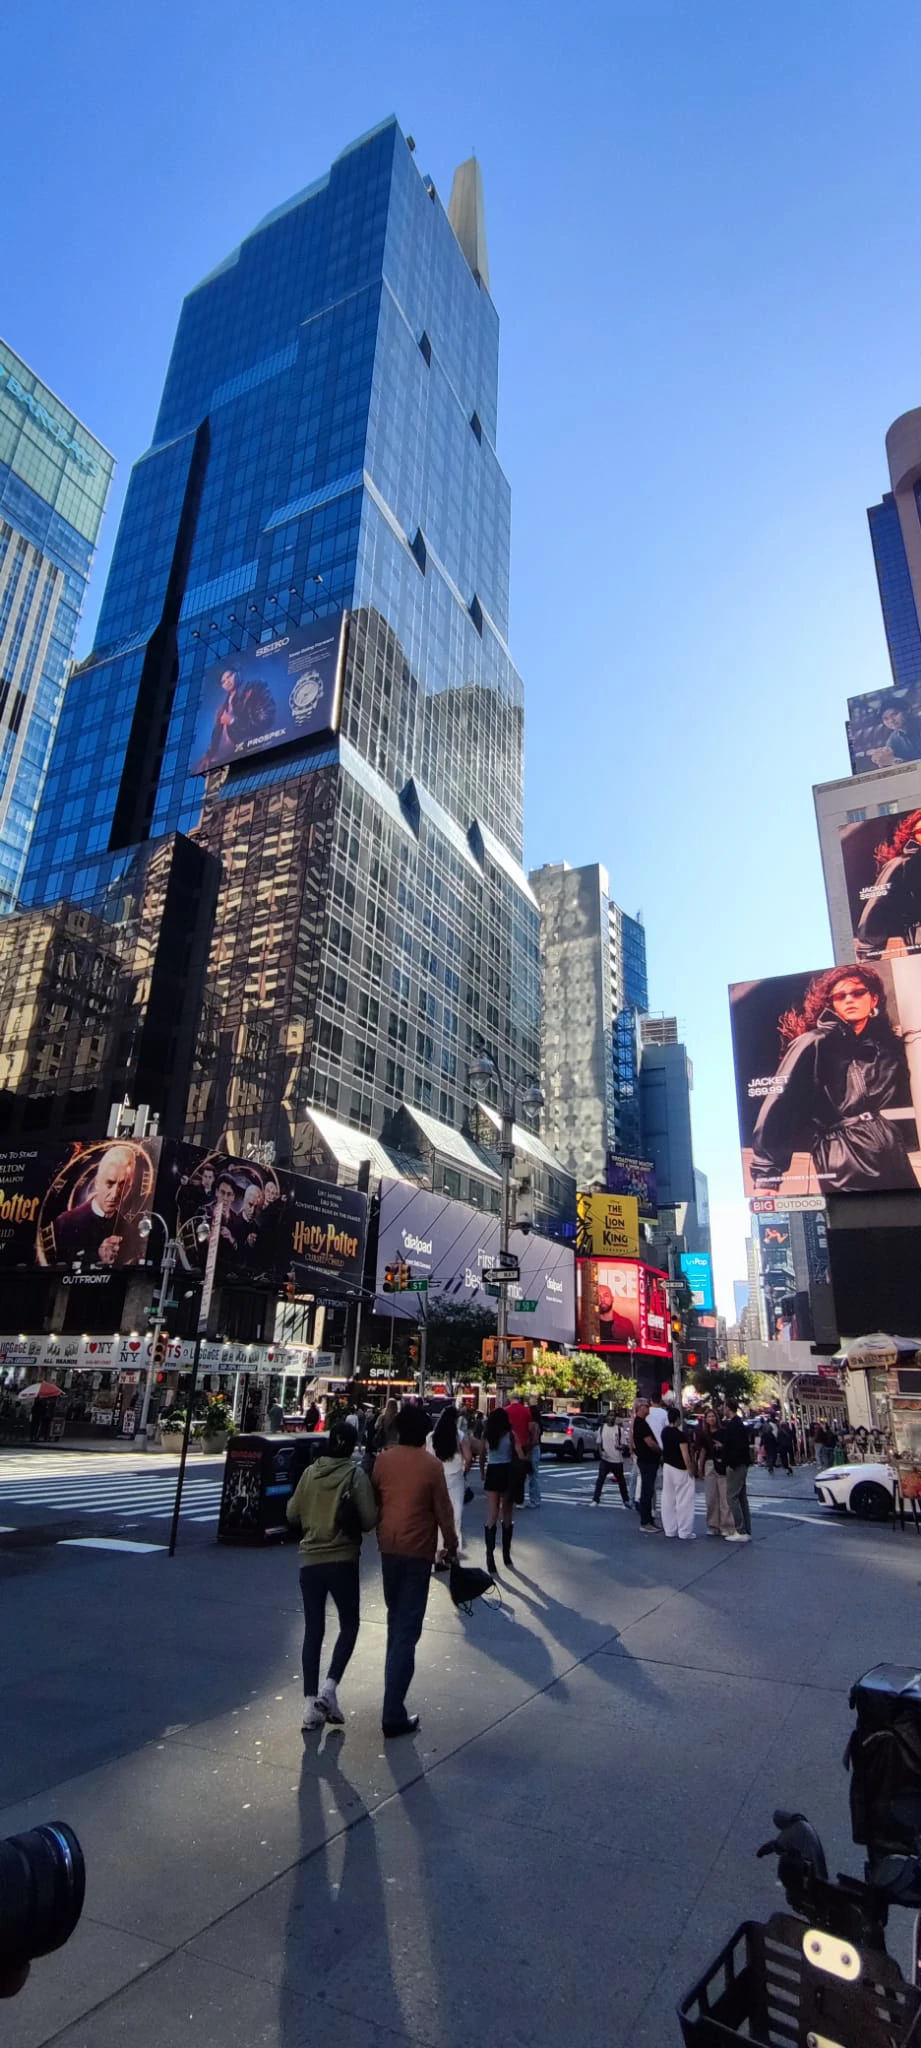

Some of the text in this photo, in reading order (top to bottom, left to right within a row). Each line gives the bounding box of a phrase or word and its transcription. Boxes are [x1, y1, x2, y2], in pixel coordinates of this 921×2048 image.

[256, 637, 290, 657] SEIKO
[247, 727, 286, 748] PROSPEX
[859, 883, 892, 894] JACKET
[748, 1075, 789, 1088] JACKET
[748, 1086, 783, 1098] $69.99
[9, 1151, 19, 1160] TO
[608, 1204, 622, 1214] THE
[753, 1199, 823, 1211] BIG OUTDOOR
[605, 1215, 625, 1229] LION
[291, 1221, 358, 1257] Harry Potter
[404, 1233, 433, 1255] dialpad
[603, 1230, 628, 1246] KING
[477, 1247, 495, 1269] First
[412, 1282, 422, 1290] ST
[546, 1277, 563, 1293] dialpad
[638, 1265, 648, 1349] PATREON
[97, 1342, 114, 1354] NY
[121, 1341, 128, 1351] I
[147, 1343, 182, 1359] GTS
[119, 1352, 140, 1363] NY
